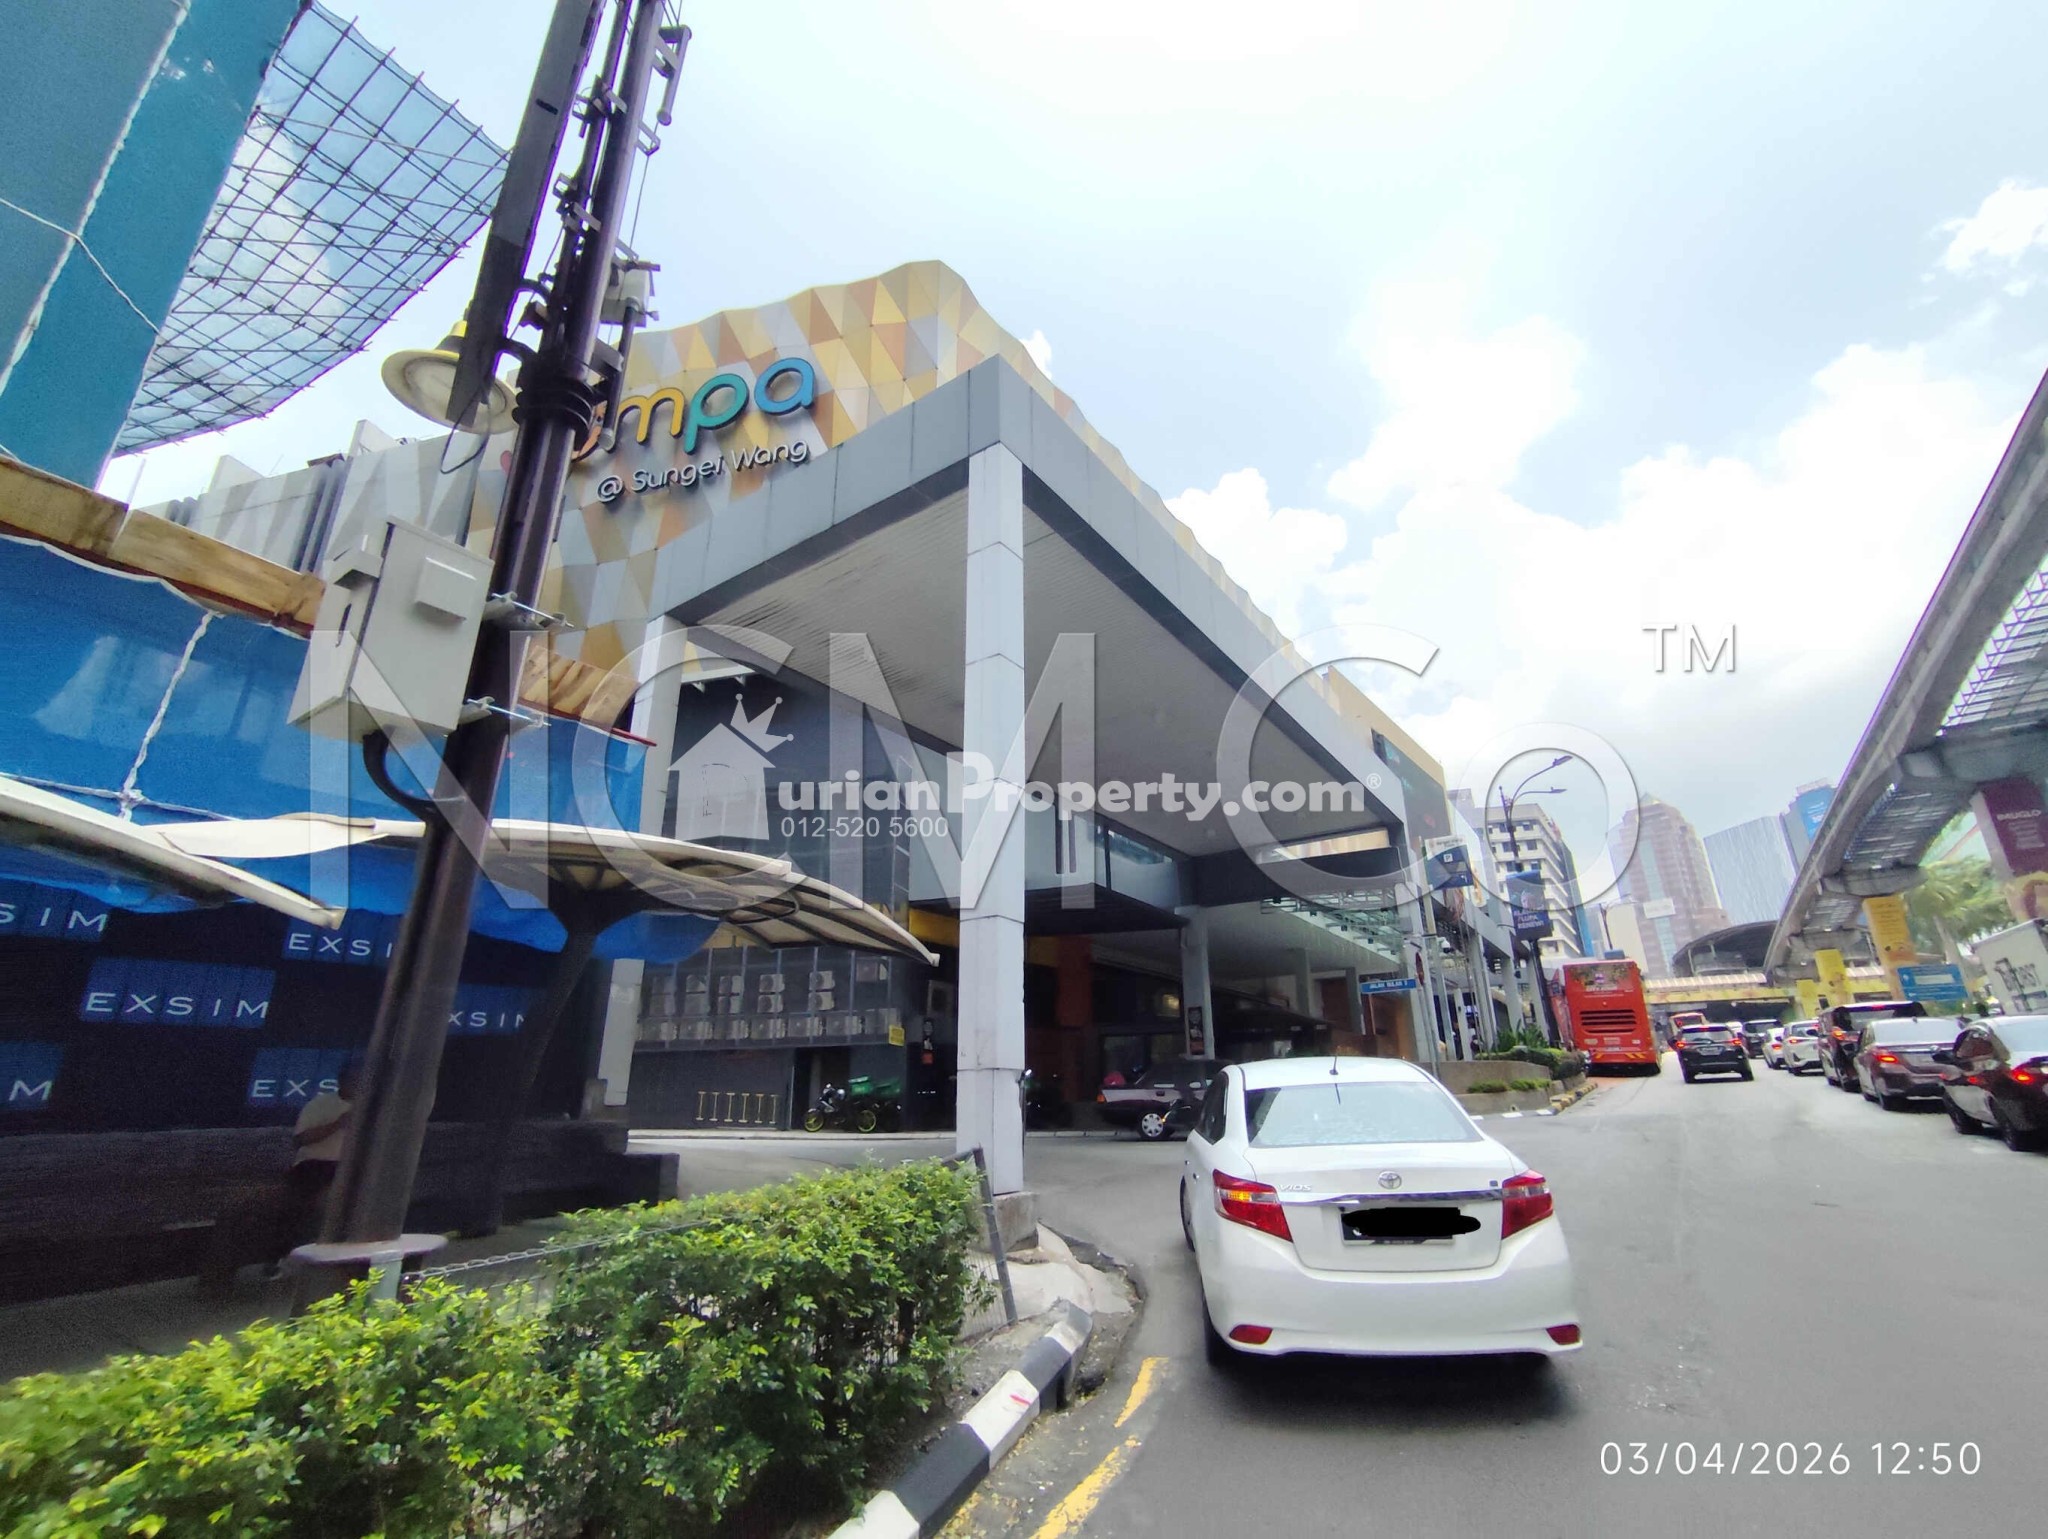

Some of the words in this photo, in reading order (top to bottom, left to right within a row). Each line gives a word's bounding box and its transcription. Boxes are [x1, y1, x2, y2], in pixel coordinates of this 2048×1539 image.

[597, 474, 624, 503] @
[631, 455, 725, 493] Sungei
[731, 438, 810, 473] Wang
[288, 932, 393, 958] EXSI
[85, 992, 270, 1020] EXSIM
[448, 1011, 525, 1028] XSI
[252, 1078, 340, 1098] EXS
